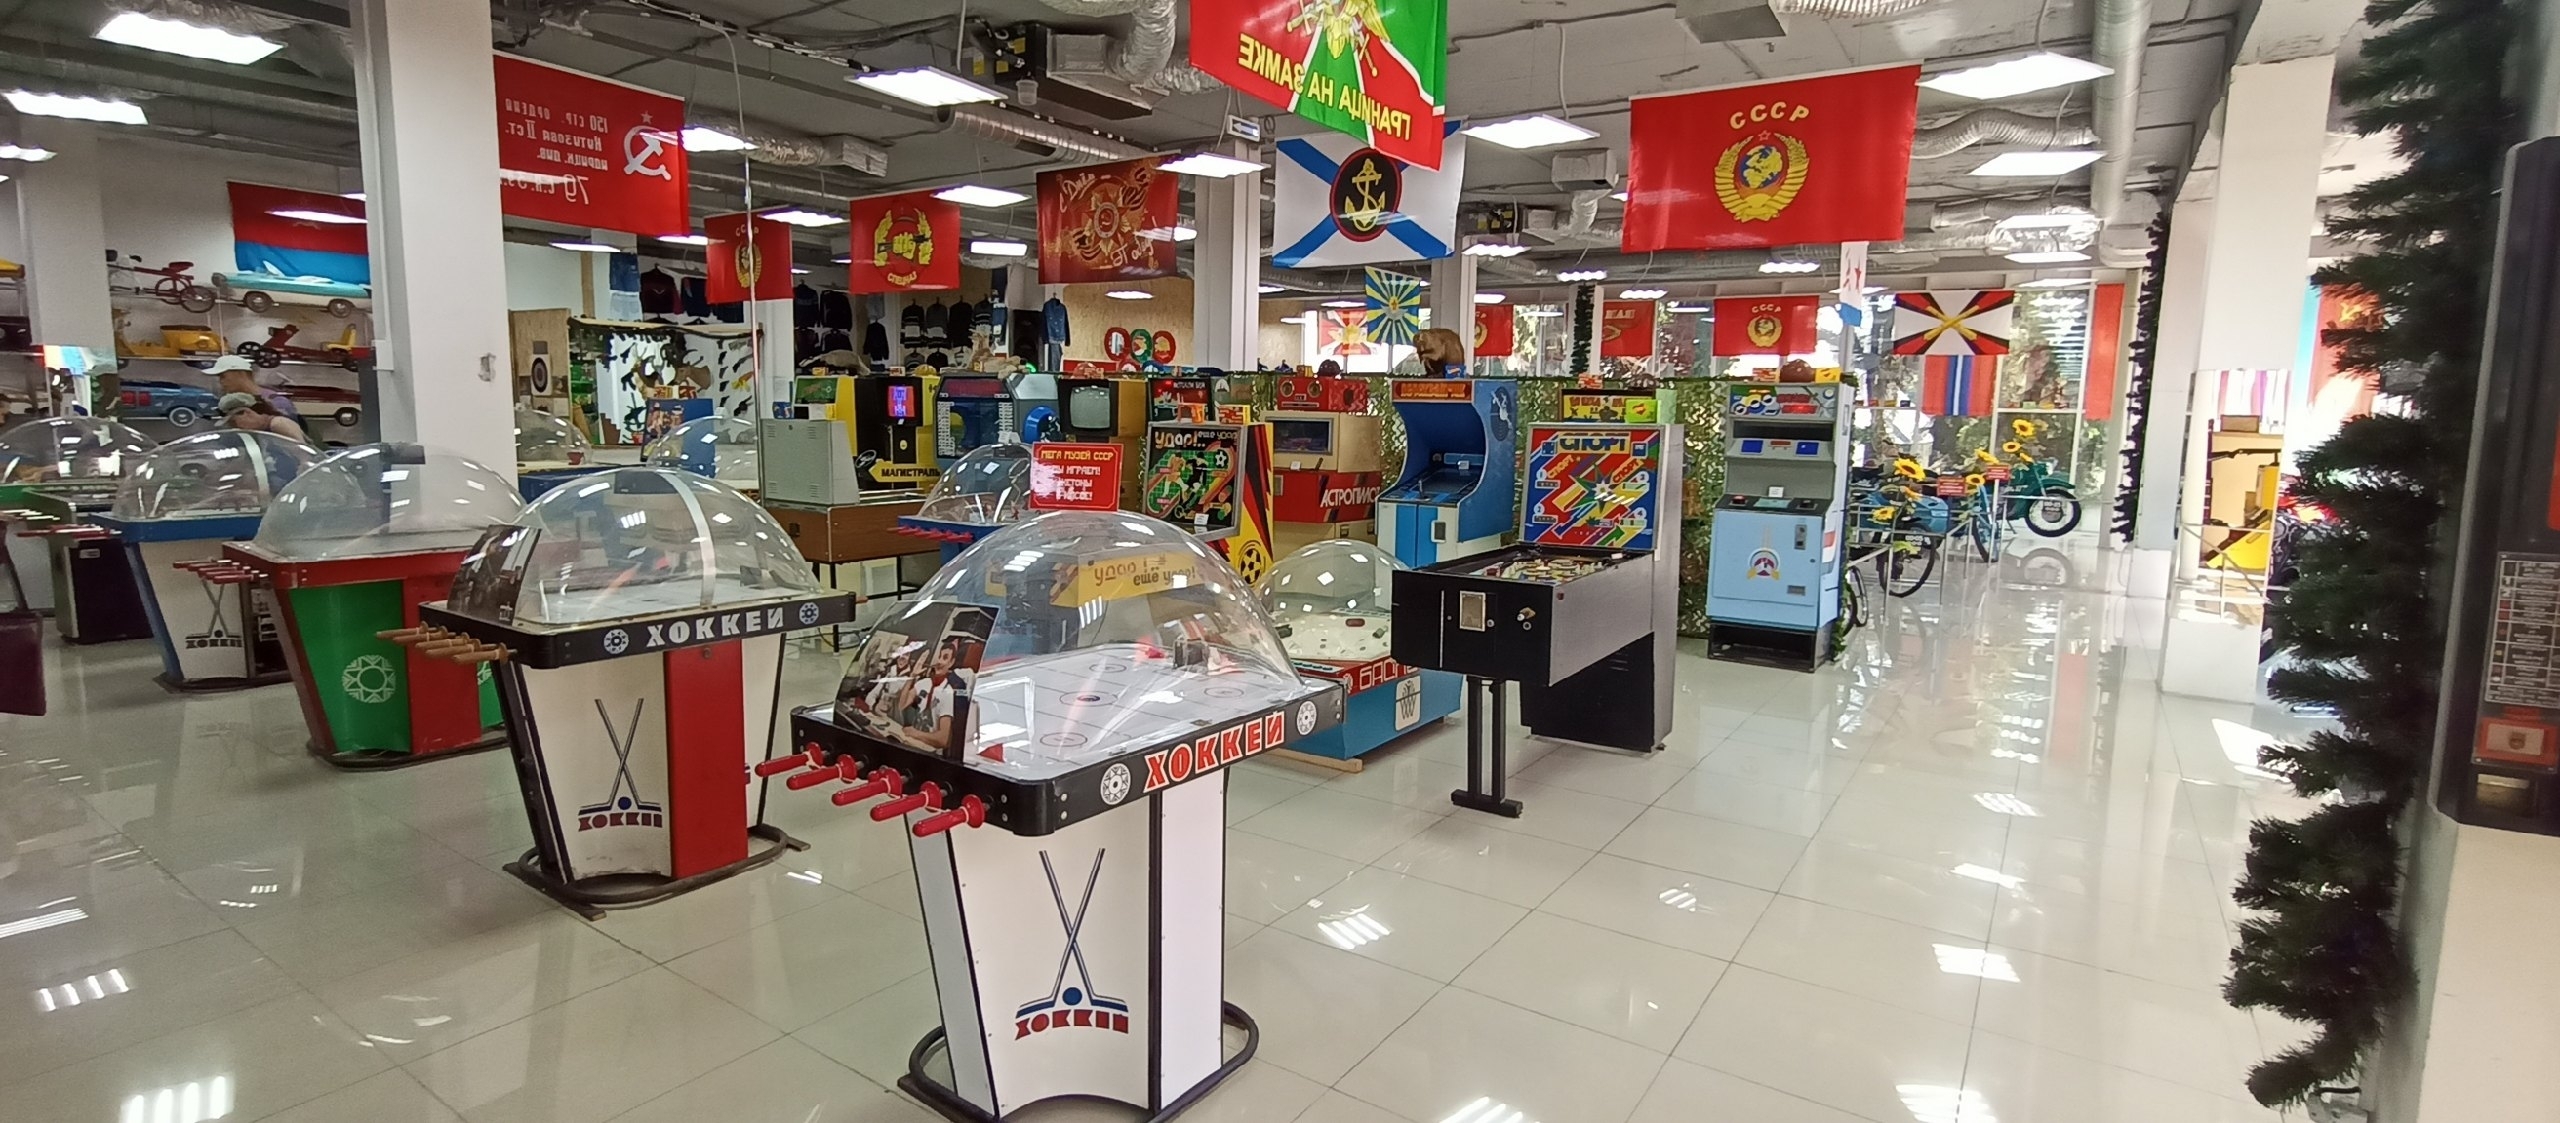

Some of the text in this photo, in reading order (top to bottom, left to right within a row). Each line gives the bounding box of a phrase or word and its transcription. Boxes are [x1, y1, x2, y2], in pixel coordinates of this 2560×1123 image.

[1729, 101, 1810, 130] СССР
[887, 271, 918, 286] СПЕЦНАЗ
[1751, 303, 1782, 313] СССР
[1559, 432, 1630, 451] СПОРТ
[1041, 450, 1114, 461] МЕГА МУЗЕЙ СССР
[881, 467, 941, 478] МАГИСТРАЛЬ
[1547, 454, 1575, 479] СПОРТ
[1612, 458, 1641, 484] СПОРТ
[1143, 710, 1285, 793] ХОККЕЙ
